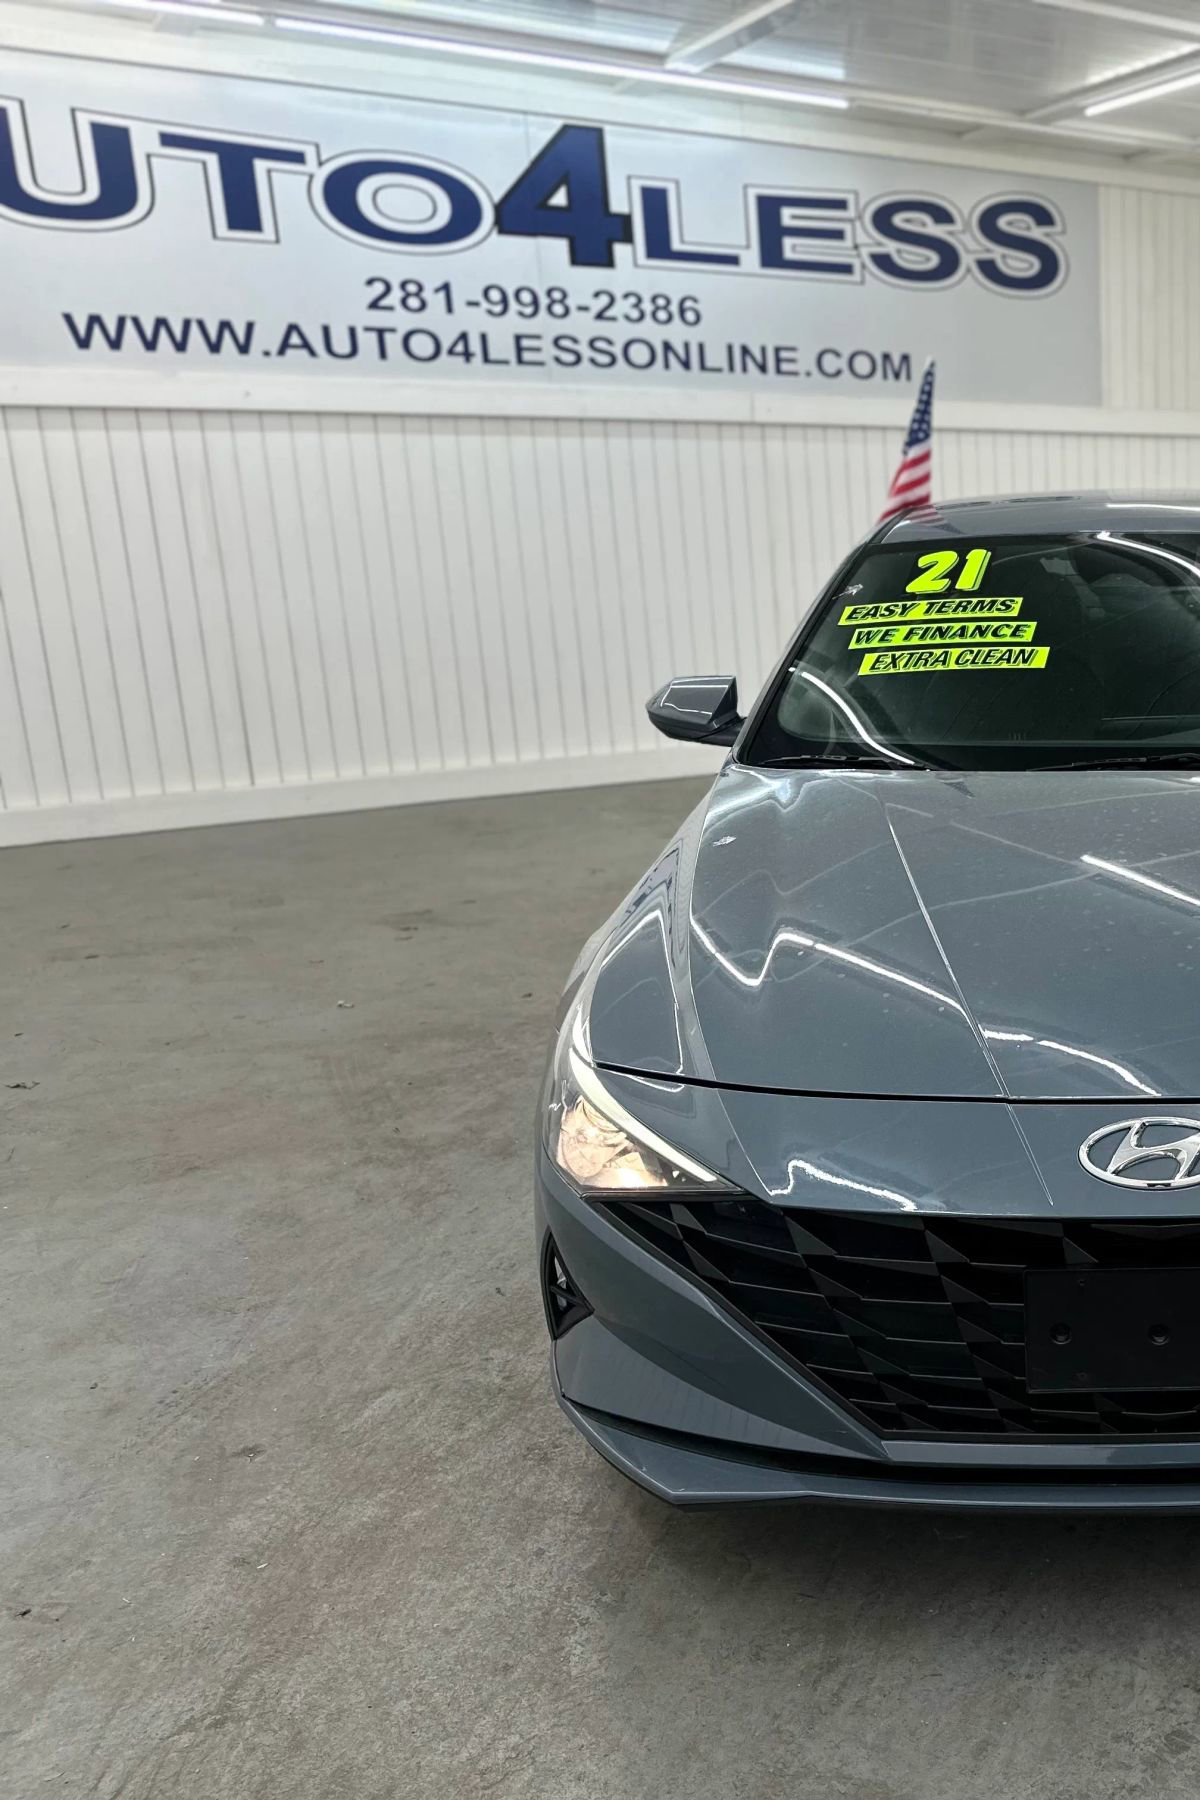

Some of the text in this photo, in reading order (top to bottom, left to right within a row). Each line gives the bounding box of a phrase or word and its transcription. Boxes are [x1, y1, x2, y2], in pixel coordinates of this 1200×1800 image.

[365, 277, 702, 327] 281-998-2386
[62, 313, 913, 381] WWW.AUTO4LESSONLINE.COM
[905, 549, 991, 593] 21
[846, 599, 1016, 620] EASY TERMS
[855, 624, 1029, 645] WE FINANCE
[869, 649, 1037, 671] EXTRA CLEAN
